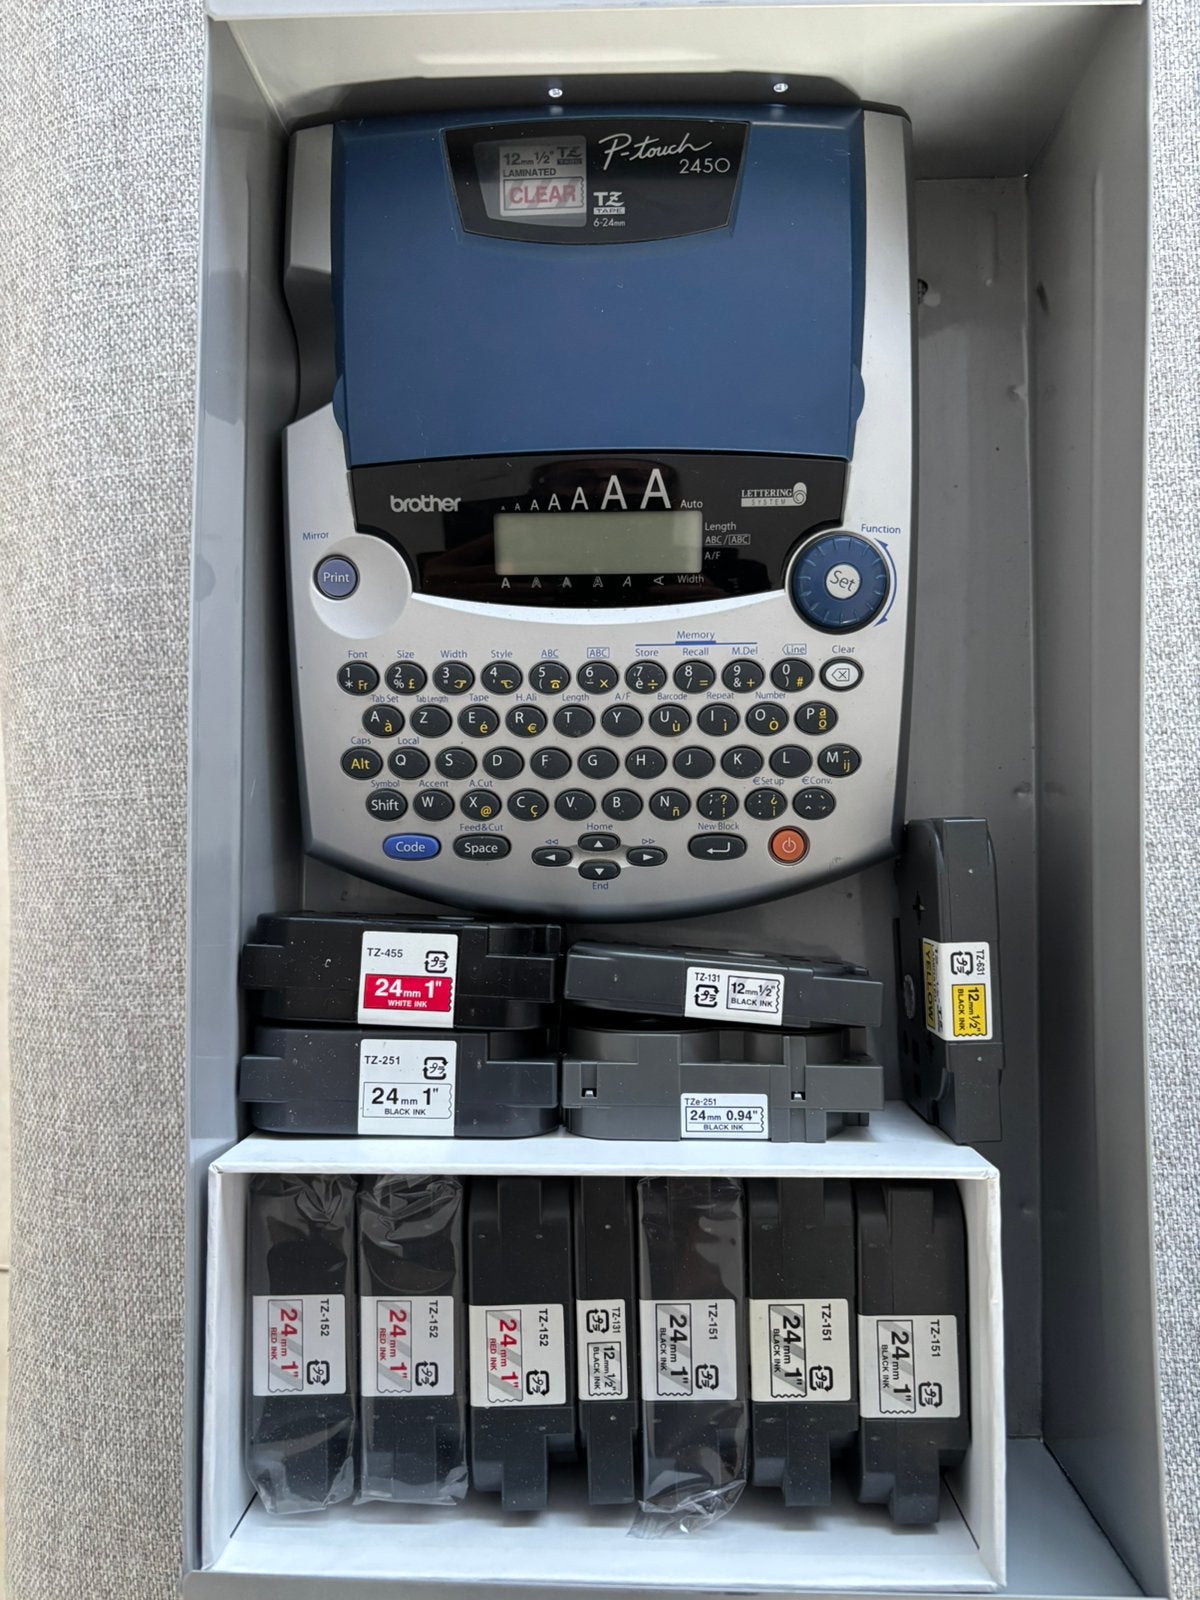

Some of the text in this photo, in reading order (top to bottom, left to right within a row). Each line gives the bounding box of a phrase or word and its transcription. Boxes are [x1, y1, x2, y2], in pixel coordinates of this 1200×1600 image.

[598, 132, 712, 171] P-touch
[679, 157, 731, 174] 2450
[502, 167, 556, 177] LAMINATED
[509, 184, 576, 204] CLEAR
[593, 217, 626, 227] 6-24mm
[741, 488, 793, 498] LETTERING
[390, 494, 462, 512] brother
[680, 499, 704, 509] Auto
[704, 522, 736, 532] Length
[861, 523, 902, 534] Function
[302, 532, 329, 541] Mirror
[704, 551, 721, 560] A/F
[323, 572, 350, 583] Print
[678, 574, 704, 584] Width
[829, 570, 856, 592] Set
[676, 630, 716, 640] Memory
[348, 650, 368, 659] Font
[396, 650, 415, 659] Size
[440, 650, 468, 659] Width
[541, 649, 559, 658] ABC
[589, 648, 608, 657] ABC
[635, 648, 659, 657] Store
[682, 647, 710, 656] Recall
[732, 646, 758, 656] M.Del
[786, 645, 806, 654] Line
[832, 644, 855, 654] Clear
[490, 650, 513, 660] Style
[394, 667, 402, 678] 2
[442, 667, 450, 678] 3
[490, 667, 498, 678] 4
[538, 667, 546, 678] 5
[586, 666, 594, 678] 6
[636, 666, 643, 676] 7
[684, 665, 692, 676] 8
[734, 665, 740, 676] 9
[372, 694, 399, 703] Tab Set
[469, 694, 490, 703] Tape
[562, 693, 590, 702] Length
[657, 692, 688, 700] Barcode
[706, 692, 734, 702] Repeat
[754, 691, 786, 700] Number
[370, 711, 380, 722] A
[420, 712, 428, 724] Z
[468, 712, 476, 724] E
[516, 712, 524, 723] R
[612, 712, 621, 723] Y
[660, 710, 670, 723] U
[755, 708, 766, 720] O
[806, 708, 815, 720] P
[350, 737, 372, 746] Caps
[398, 736, 420, 745] Local
[395, 754, 406, 766] Q
[492, 754, 502, 766] D
[588, 754, 598, 766] G
[636, 754, 646, 766] H
[734, 753, 742, 765] K
[826, 751, 839, 764] M
[351, 758, 370, 770] Alt
[370, 780, 400, 788] Symbol
[418, 780, 449, 788] Accent
[469, 780, 493, 788] A.Cut
[371, 799, 400, 812] Shift
[422, 796, 434, 808] W
[469, 796, 478, 808] X
[516, 796, 526, 808] C
[566, 796, 575, 808] V
[613, 796, 621, 808] B
[660, 796, 670, 807] N
[586, 822, 614, 831] Home
[698, 822, 740, 830] New Block
[396, 842, 426, 853] Code
[464, 842, 498, 856] Space
[592, 882, 609, 890] End
[366, 947, 404, 958] TZ-455
[976, 949, 985, 976] TZ-631
[694, 972, 720, 982] TZ-131
[388, 999, 428, 1008] WHITE INK
[731, 998, 773, 1008] BLACK INK
[364, 1055, 400, 1065] TZ-251
[684, 1098, 716, 1106] TZe-251
[384, 1108, 426, 1116] BLACK INK
[320, 1298, 330, 1337] TZ-152
[428, 1300, 438, 1338] TZ-152
[612, 1306, 621, 1334] TZ-131
[708, 1302, 718, 1340] TZ-151
[822, 1304, 832, 1342] TZ-151
[538, 1308, 549, 1347] TZ-152
[270, 1327, 278, 1360] RED INK
[930, 1319, 941, 1357] TZ-151
[378, 1328, 387, 1361] RED INK
[489, 1338, 498, 1370] RED INK
[660, 1358, 668, 1371] INK
[774, 1359, 782, 1372] INK
[882, 1374, 890, 1388] INK
